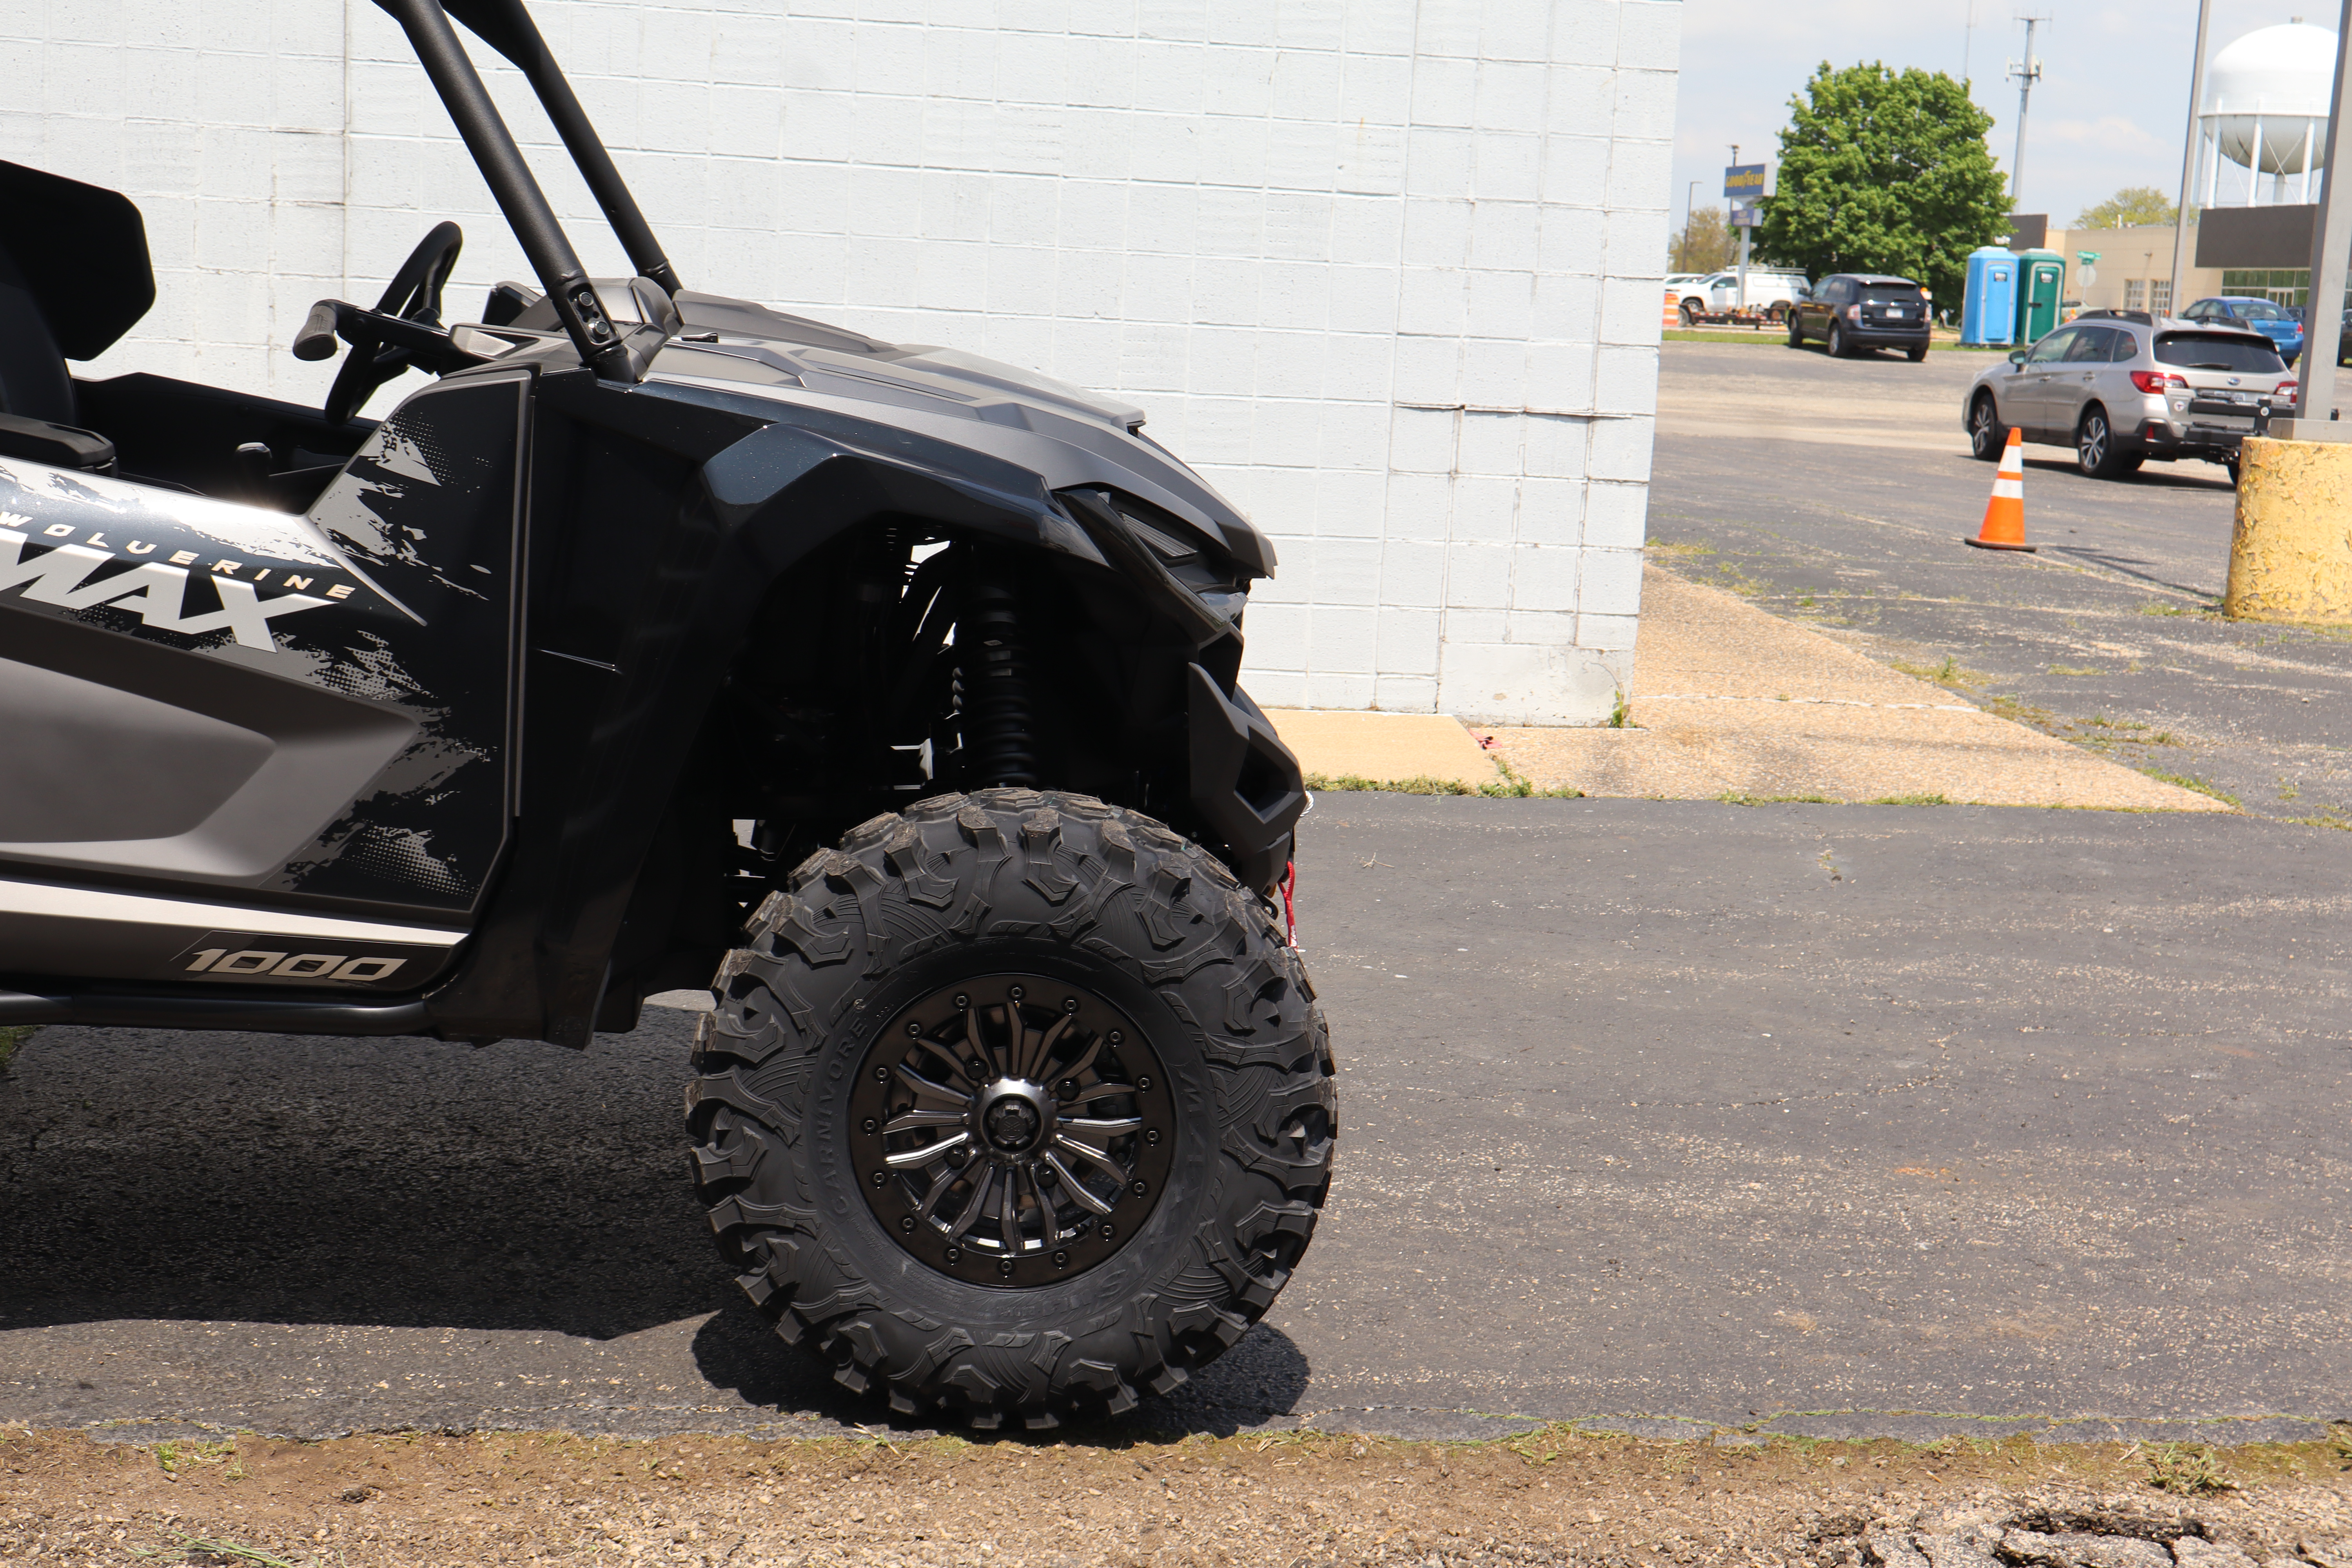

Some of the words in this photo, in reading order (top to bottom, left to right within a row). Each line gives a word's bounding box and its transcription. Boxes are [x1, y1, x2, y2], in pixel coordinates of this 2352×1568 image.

[0, 511, 356, 599] WOLVERINE
[185, 948, 408, 981] 1000
[817, 1018, 867, 1214] CARNIVORE
